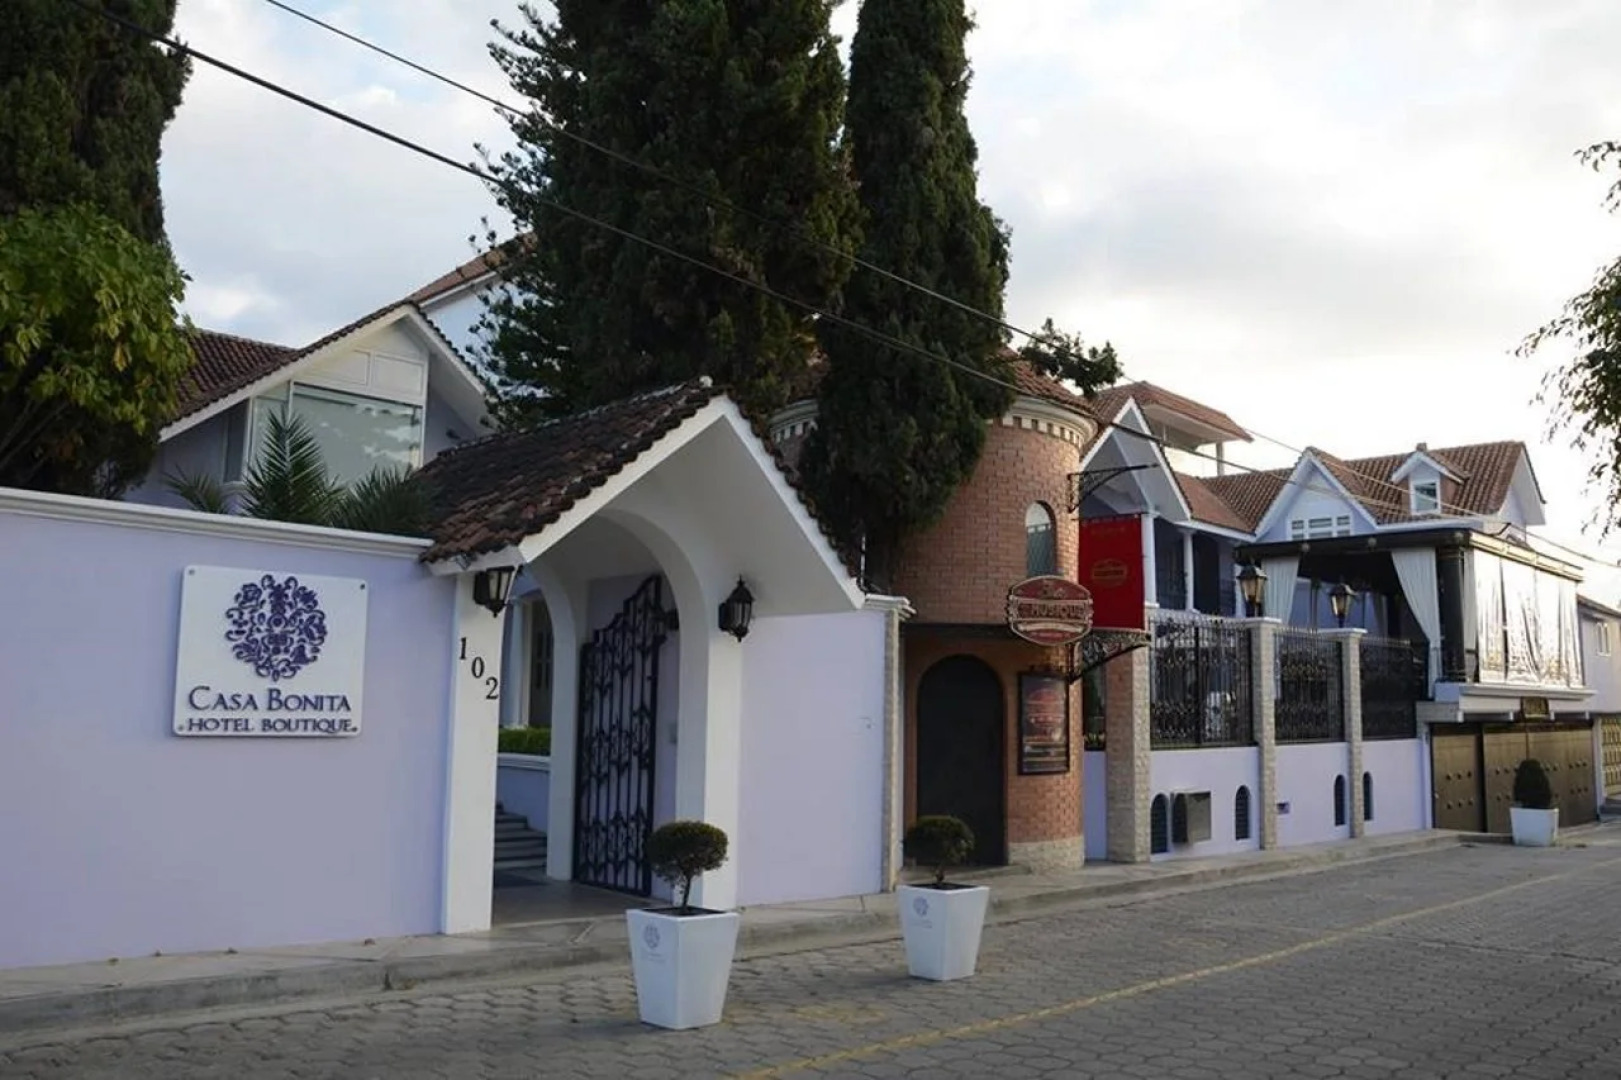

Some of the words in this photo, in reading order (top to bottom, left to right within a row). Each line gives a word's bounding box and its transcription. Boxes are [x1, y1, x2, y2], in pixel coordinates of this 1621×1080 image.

[459, 636, 499, 700] 102
[188, 685, 258, 711] CASA
[266, 687, 352, 713] BONITA
[187, 716, 253, 732] HOTEL
[261, 717, 352, 734] BOUTIQUE
